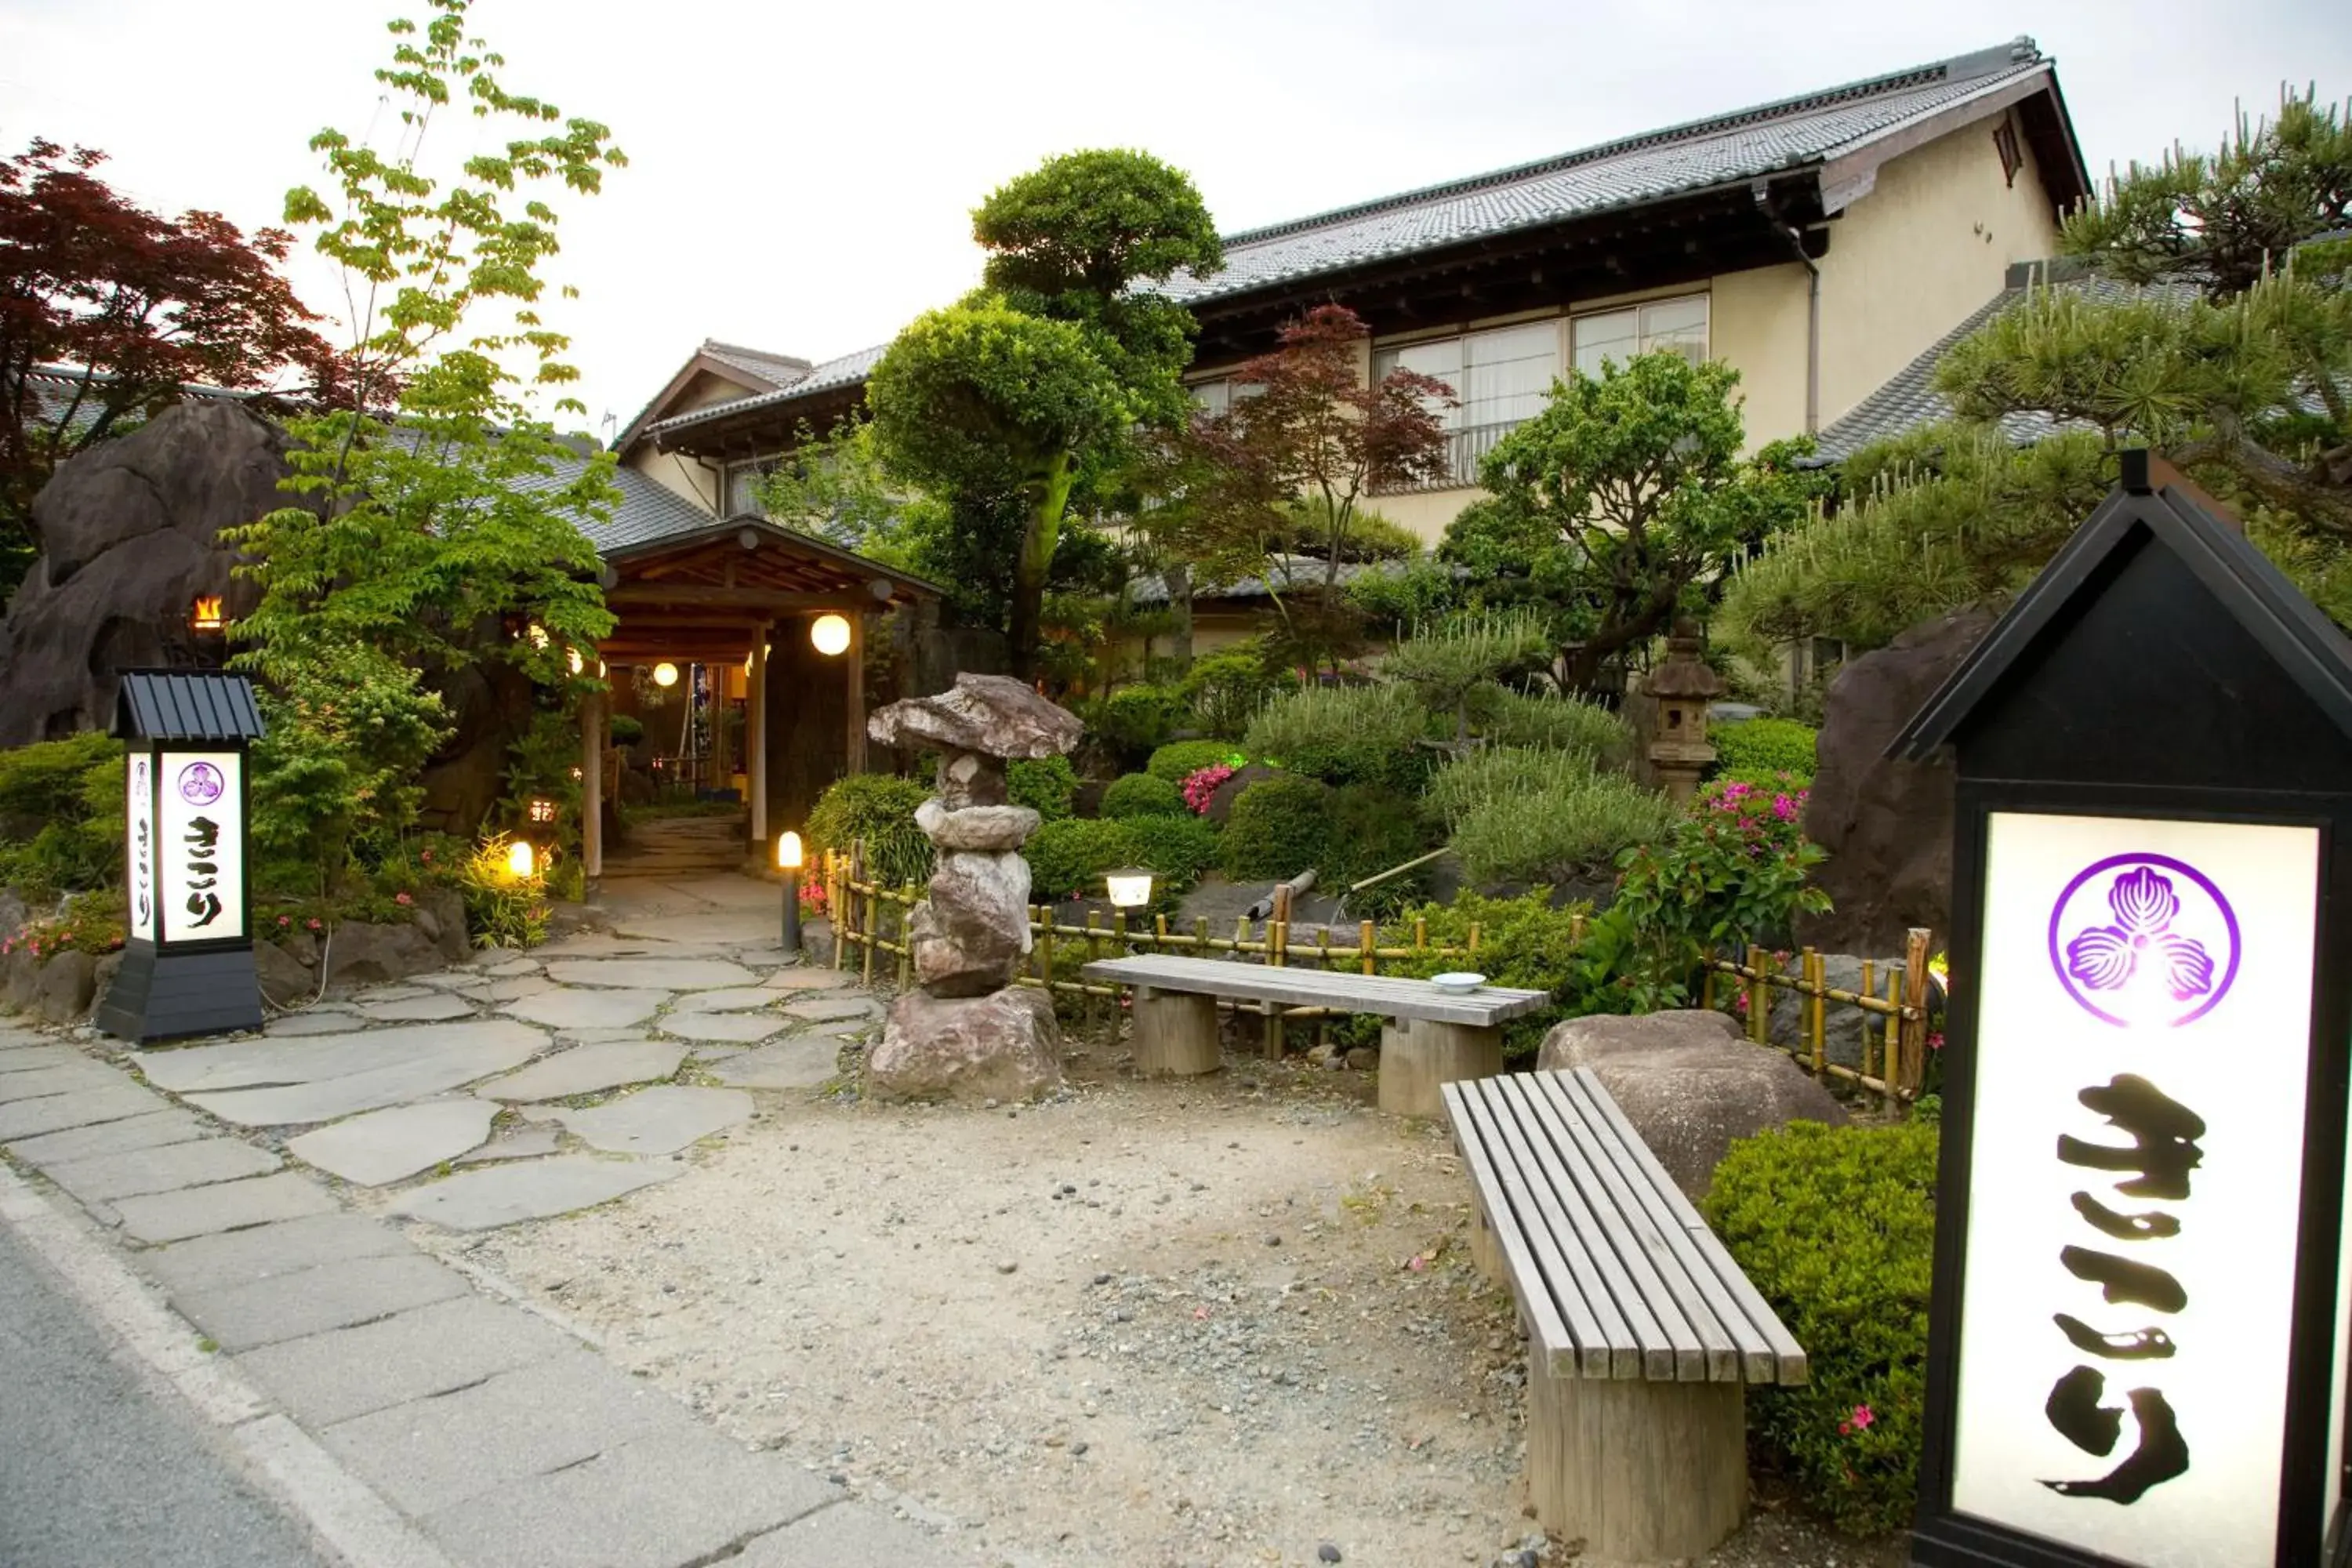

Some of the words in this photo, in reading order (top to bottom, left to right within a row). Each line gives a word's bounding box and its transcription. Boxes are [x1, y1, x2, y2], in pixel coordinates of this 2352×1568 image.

[138, 817, 151, 927] きこり
[183, 815, 222, 929] きこり
[2034, 1073, 2207, 1505] きこり
